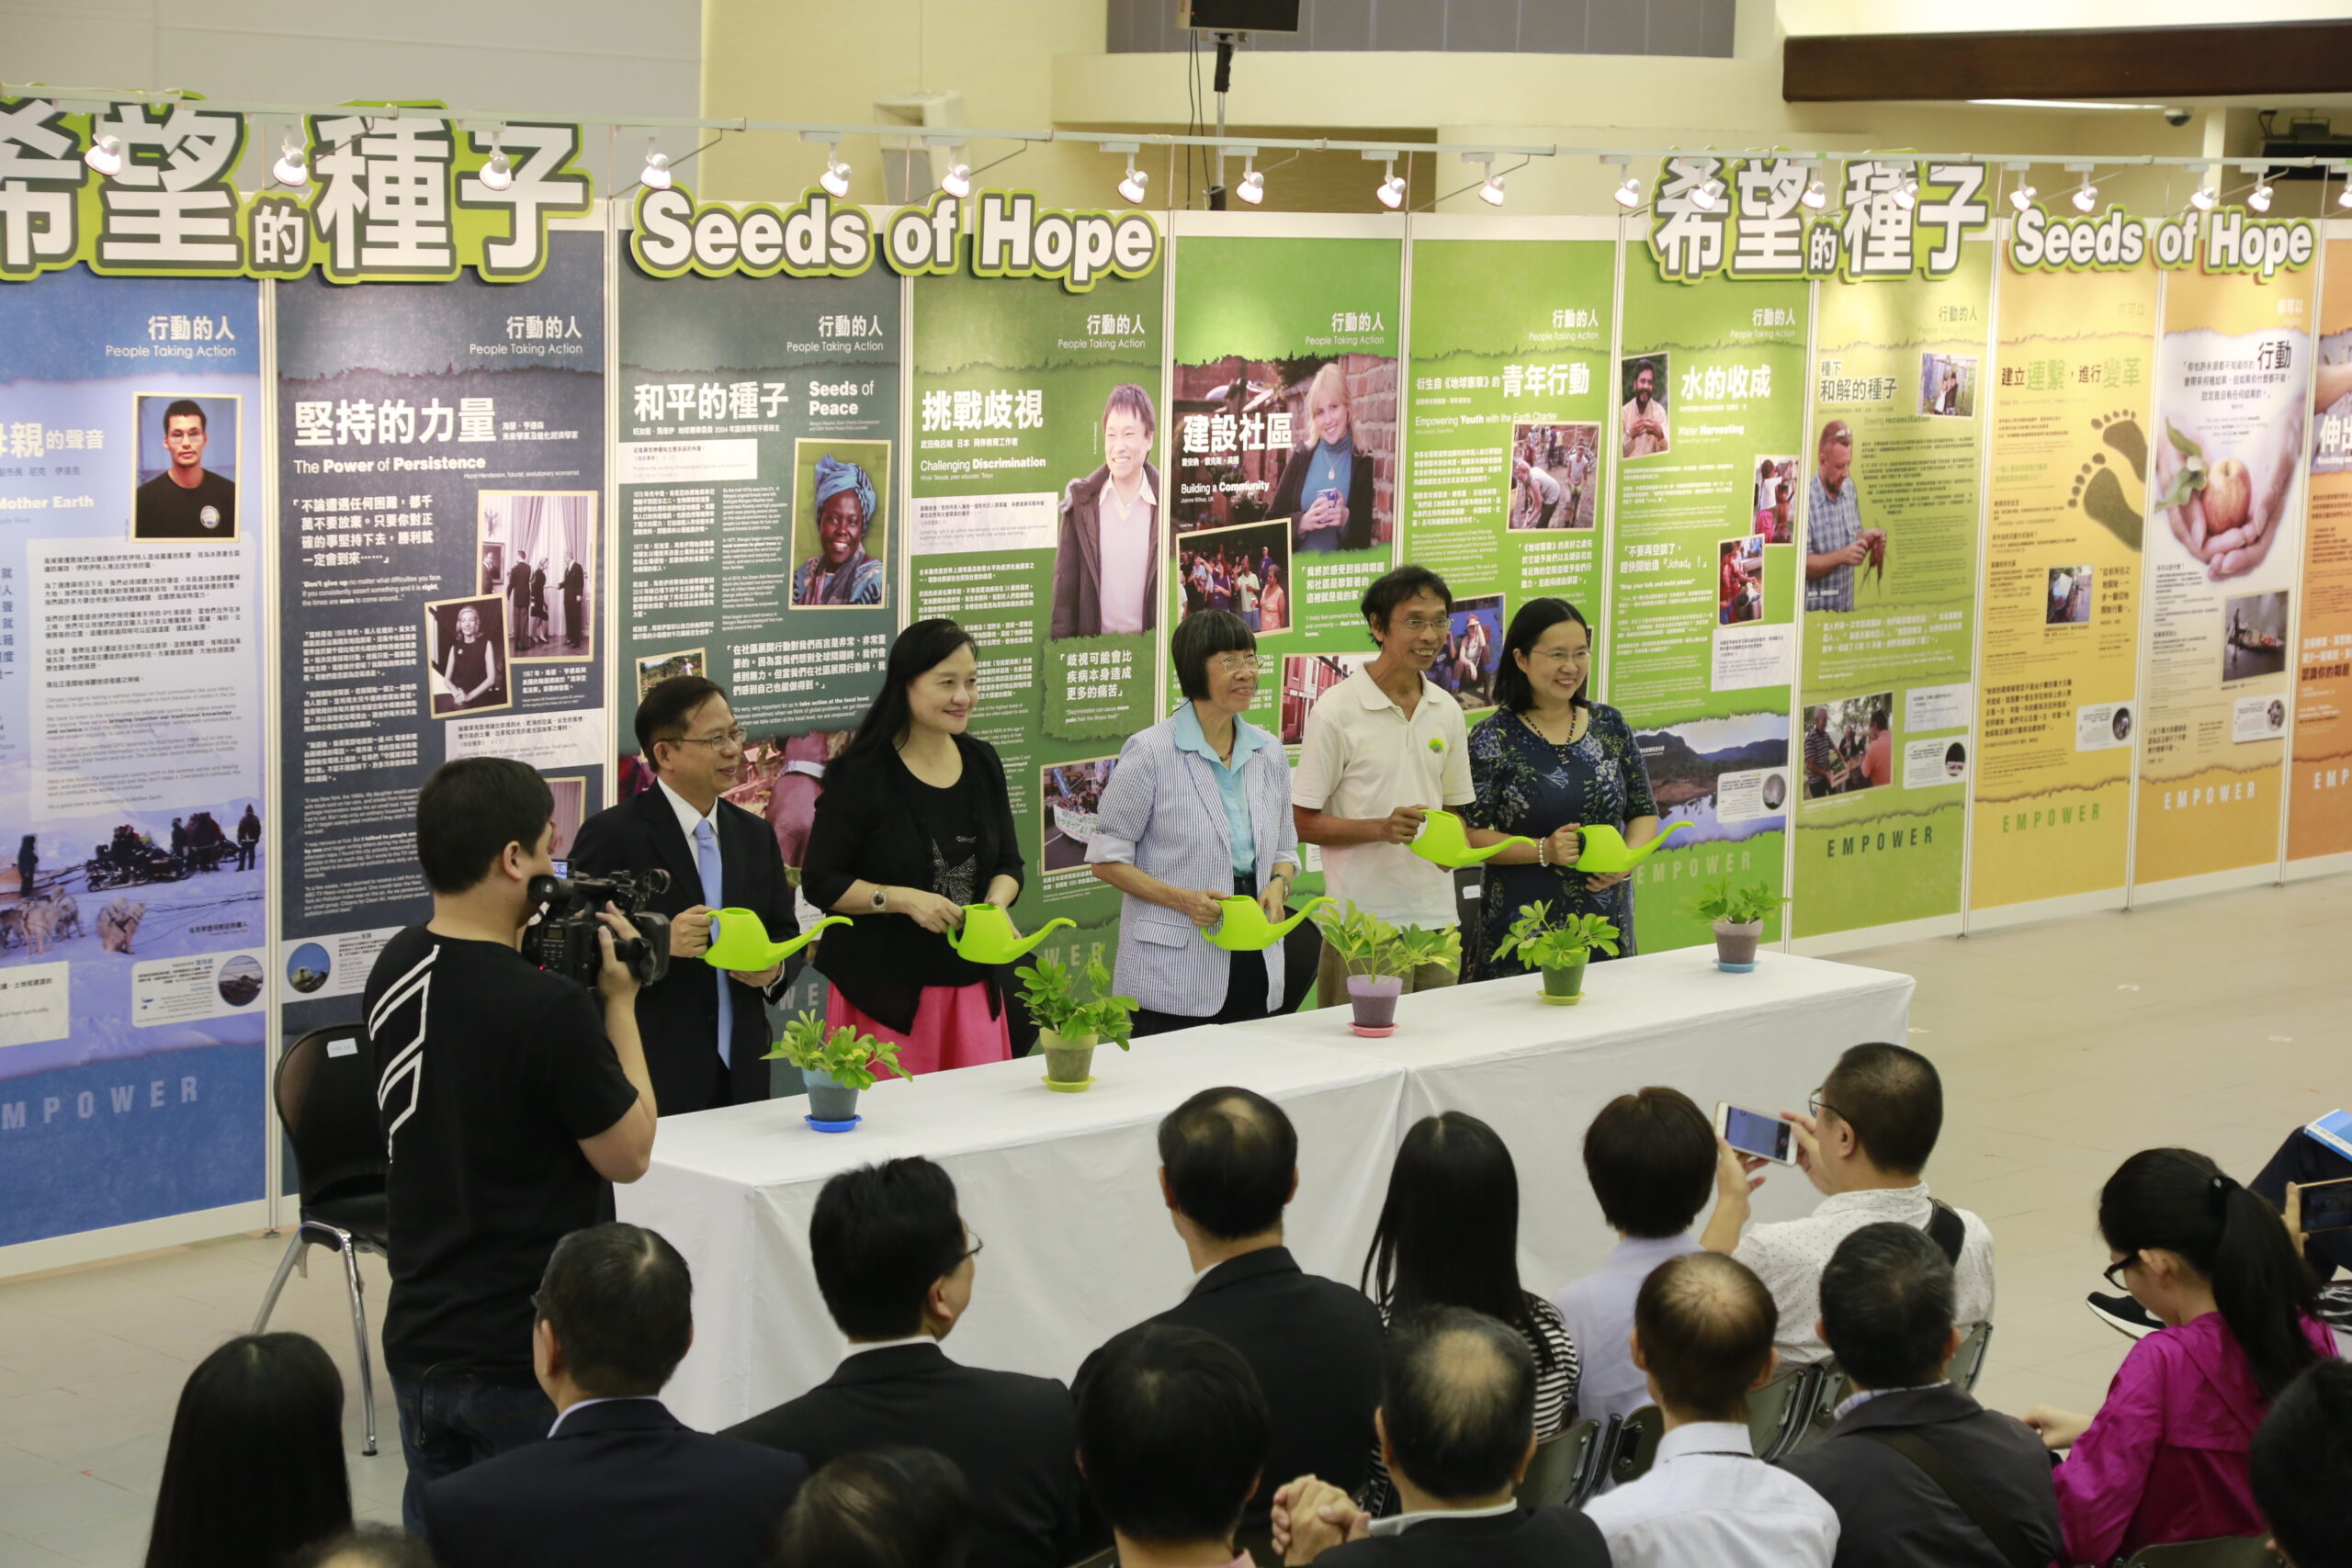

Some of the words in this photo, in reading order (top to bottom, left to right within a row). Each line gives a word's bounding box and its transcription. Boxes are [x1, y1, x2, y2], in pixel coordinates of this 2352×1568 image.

[1656, 157, 1986, 274] 希望的種子
[642, 192, 868, 265] Seeds
[893, 198, 958, 263] of
[981, 198, 1153, 281] Hope
[2015, 209, 2143, 265] Seeds
[2159, 212, 2198, 263] of
[2210, 212, 2312, 276] Hope
[1332, 312, 1385, 333] 行動的人
[1553, 310, 1599, 328] 行動的人
[1939, 306, 1977, 321] 行動的人
[148, 316, 235, 341] 行動的人
[506, 316, 582, 340] 行動的人
[818, 316, 883, 338] 行動的人
[1087, 314, 1145, 336] 行動的人
[1057, 339, 1087, 352] People
[1090, 339, 1116, 352] Taking
[1118, 338, 1145, 349] Action
[1306, 336, 1331, 346] People
[1334, 335, 1358, 346] Taking
[1359, 335, 1385, 344] Action
[1529, 333, 1553, 342] People
[1555, 332, 1576, 342] Taking
[1577, 332, 1599, 340] Action
[106, 344, 150, 358] People
[153, 344, 193, 358] Taking
[197, 344, 236, 357] Action
[469, 343, 508, 357] People
[511, 343, 545, 357] Taking
[548, 343, 582, 355] Action
[786, 342, 819, 355] People
[821, 341, 851, 355] Taking
[854, 341, 884, 353] Action
[2258, 340, 2291, 370] 行動
[1821, 361, 1842, 377] 種下
[809, 381, 857, 396] Seeds
[861, 380, 875, 395] of
[1502, 362, 1590, 398] 青年行動
[1681, 365, 1771, 400] 水的收成
[1820, 378, 1897, 402] 和解的種子
[633, 382, 789, 422] 和平的種子
[809, 400, 859, 416] Peace
[922, 389, 1044, 432] 挑戰歧視
[294, 398, 496, 446] 堅持的力量
[1415, 416, 1458, 427] Empowering
[1460, 414, 1484, 424] Youth
[1486, 414, 1499, 423] with
[1500, 413, 1511, 422] the
[1513, 412, 1531, 422] Earth
[1532, 412, 1557, 421] Charter
[1885, 415, 1931, 425] reconciliation
[1183, 412, 1293, 453] 建設社區
[1678, 426, 1699, 436] Water
[1700, 423, 1744, 436] Harvesting
[294, 459, 319, 474] The
[323, 458, 374, 473] Power
[377, 457, 390, 471] of
[393, 456, 486, 471] Persistence
[921, 459, 970, 472] Challenging
[972, 457, 1046, 469] Discrimination
[1181, 483, 1211, 495] Building
[1218, 480, 1270, 491] Community
[52, 496, 95, 508] Earth
[1059, 649, 1132, 667] 「歧視可能會比
[1067, 665, 1132, 683] 疾病本身造成
[1066, 683, 1123, 701] 更多的痛苦」
[2164, 782, 2256, 810] EMPOWER
[2002, 803, 2100, 833] EMPOWER
[1826, 826, 1933, 858] EMPOWER
[1637, 851, 1751, 885] EMPOWER
